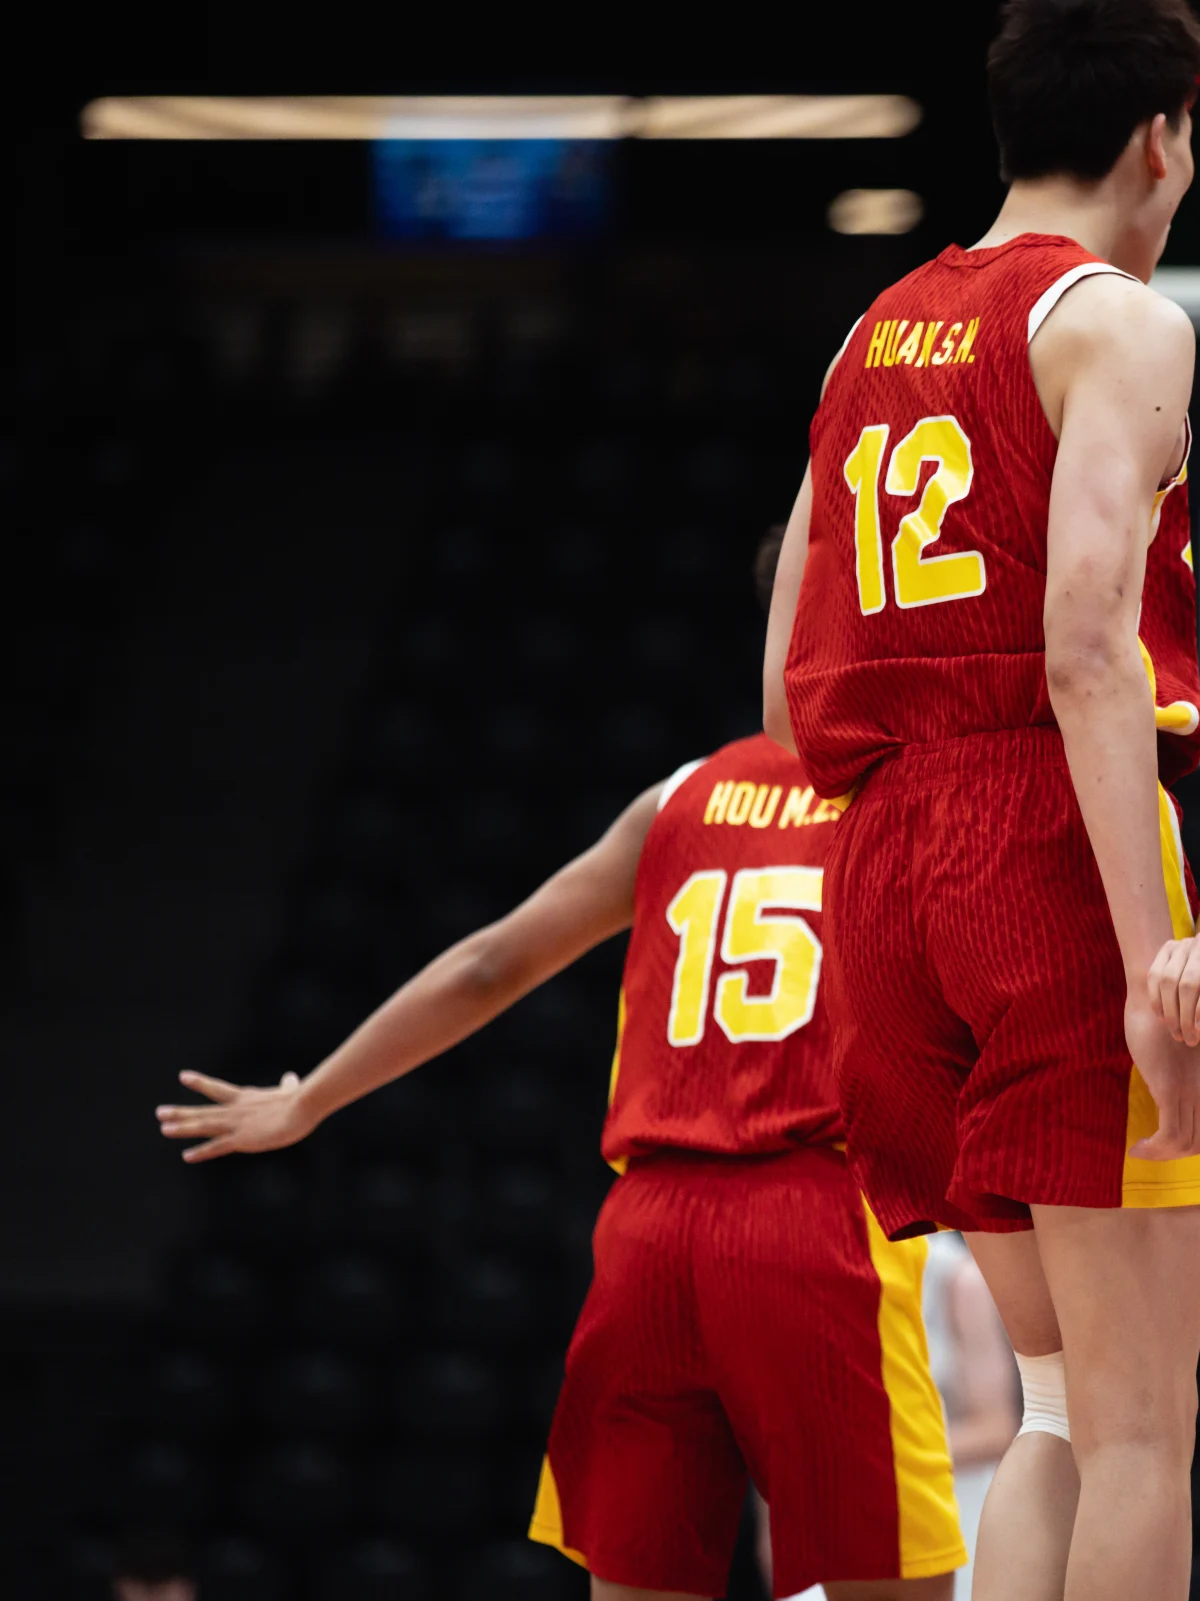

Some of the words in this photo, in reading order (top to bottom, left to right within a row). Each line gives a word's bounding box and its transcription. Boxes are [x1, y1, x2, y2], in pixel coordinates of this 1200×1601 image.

[844, 415, 986, 616] 12
[703, 780, 783, 828] HOU
[665, 864, 824, 1048] 15
